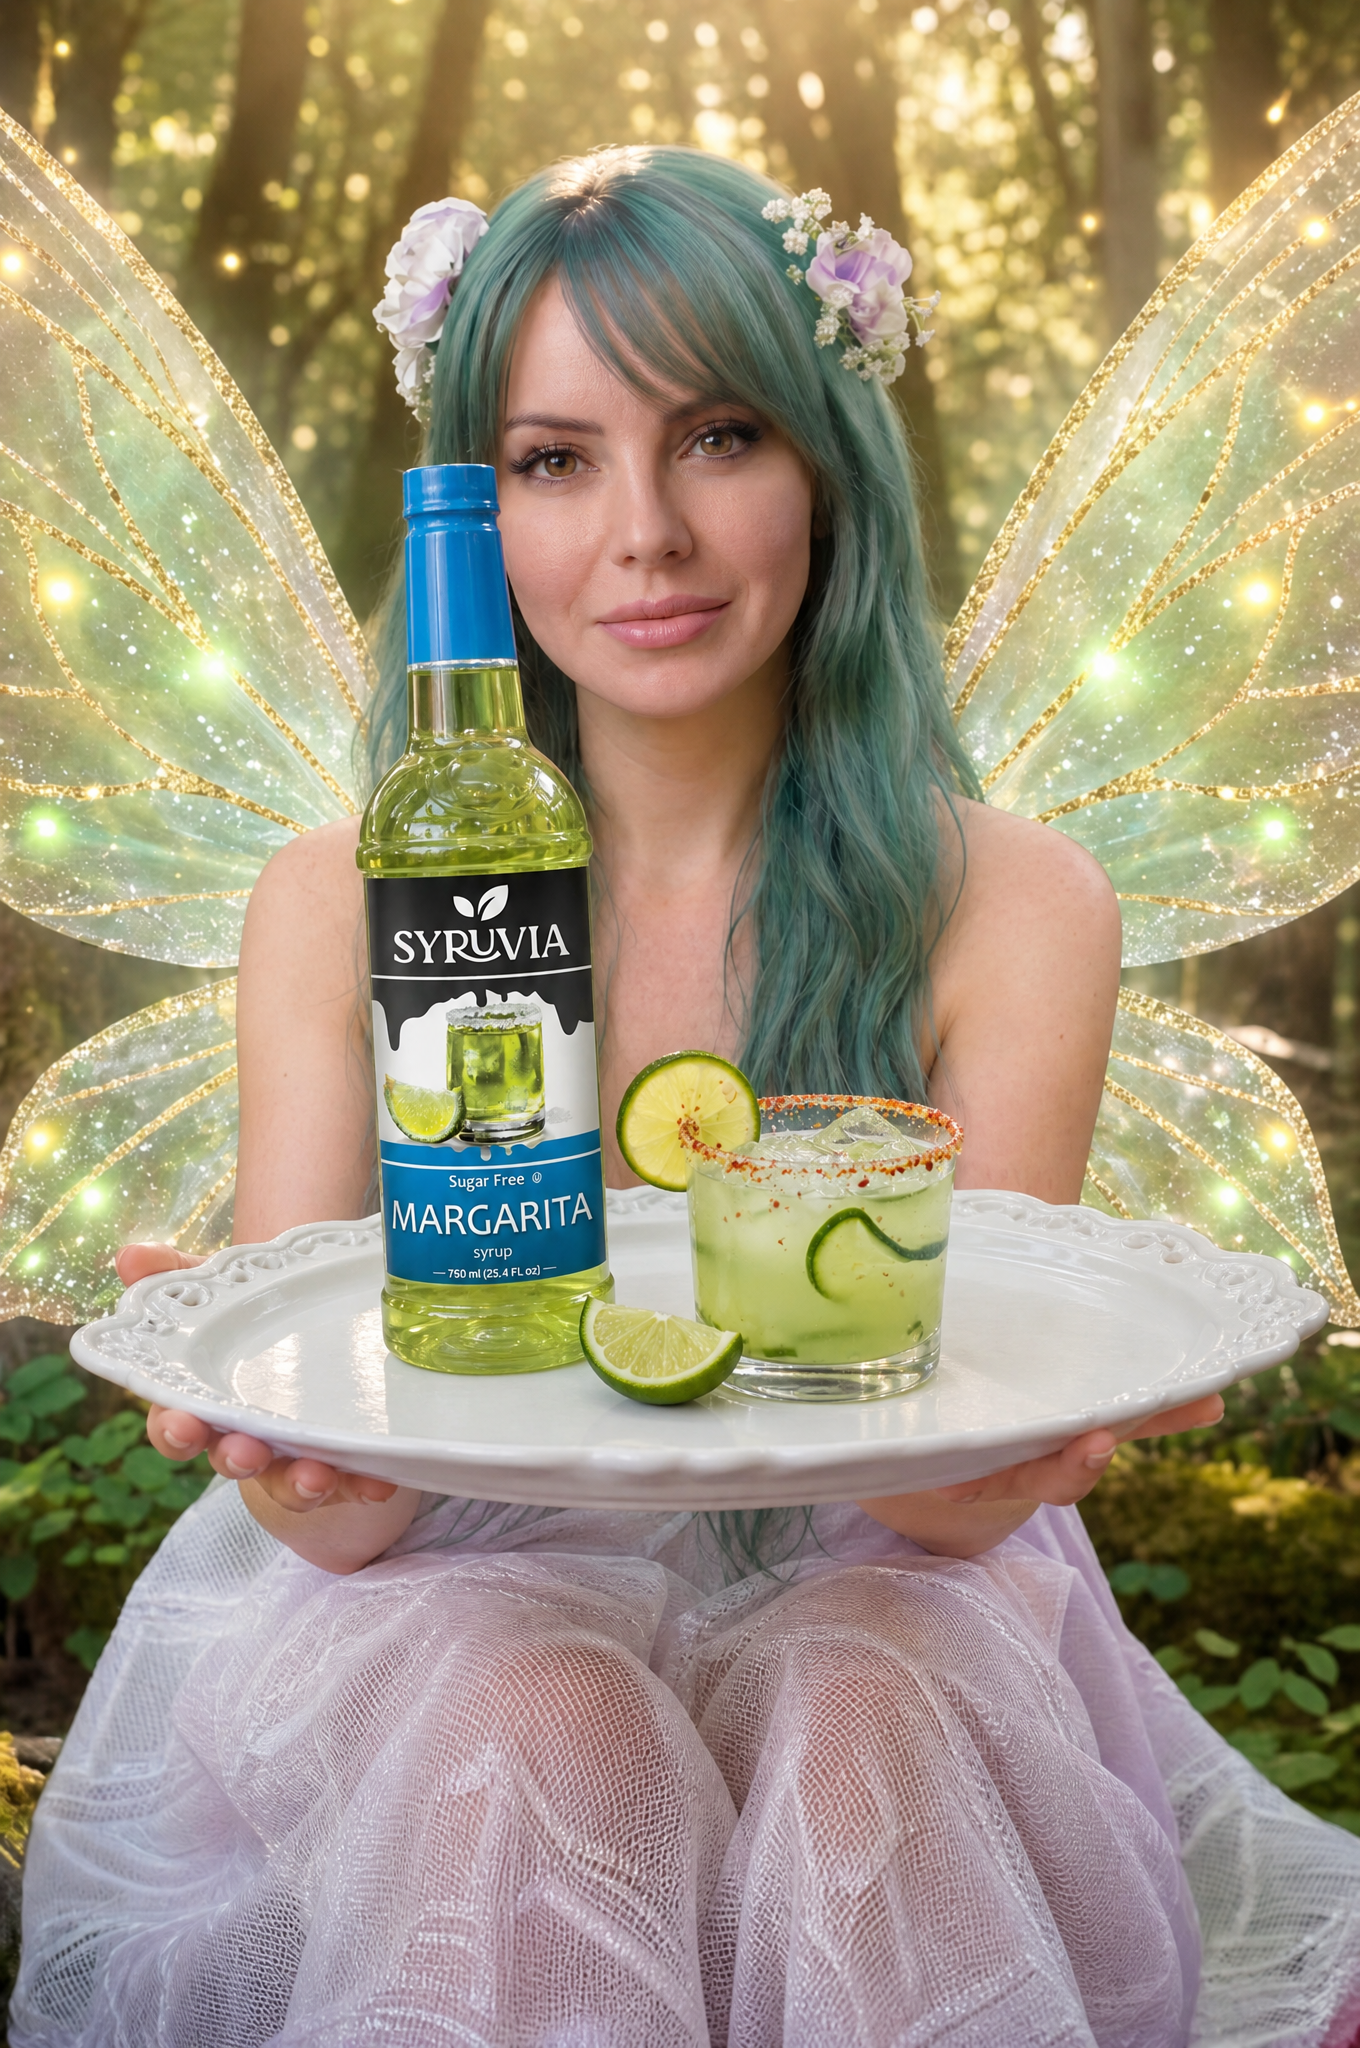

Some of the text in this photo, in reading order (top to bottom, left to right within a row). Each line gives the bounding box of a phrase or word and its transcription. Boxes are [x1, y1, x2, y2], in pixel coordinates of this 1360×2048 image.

[393, 923, 570, 964] SYRUVIA
[449, 1175, 489, 1192] Sugar
[494, 1173, 525, 1187] Free
[392, 1192, 593, 1236] MARGARITA
[473, 1246, 513, 1261] syrup
[448, 1264, 541, 1280] 750 ml (25.4 FL oz)
